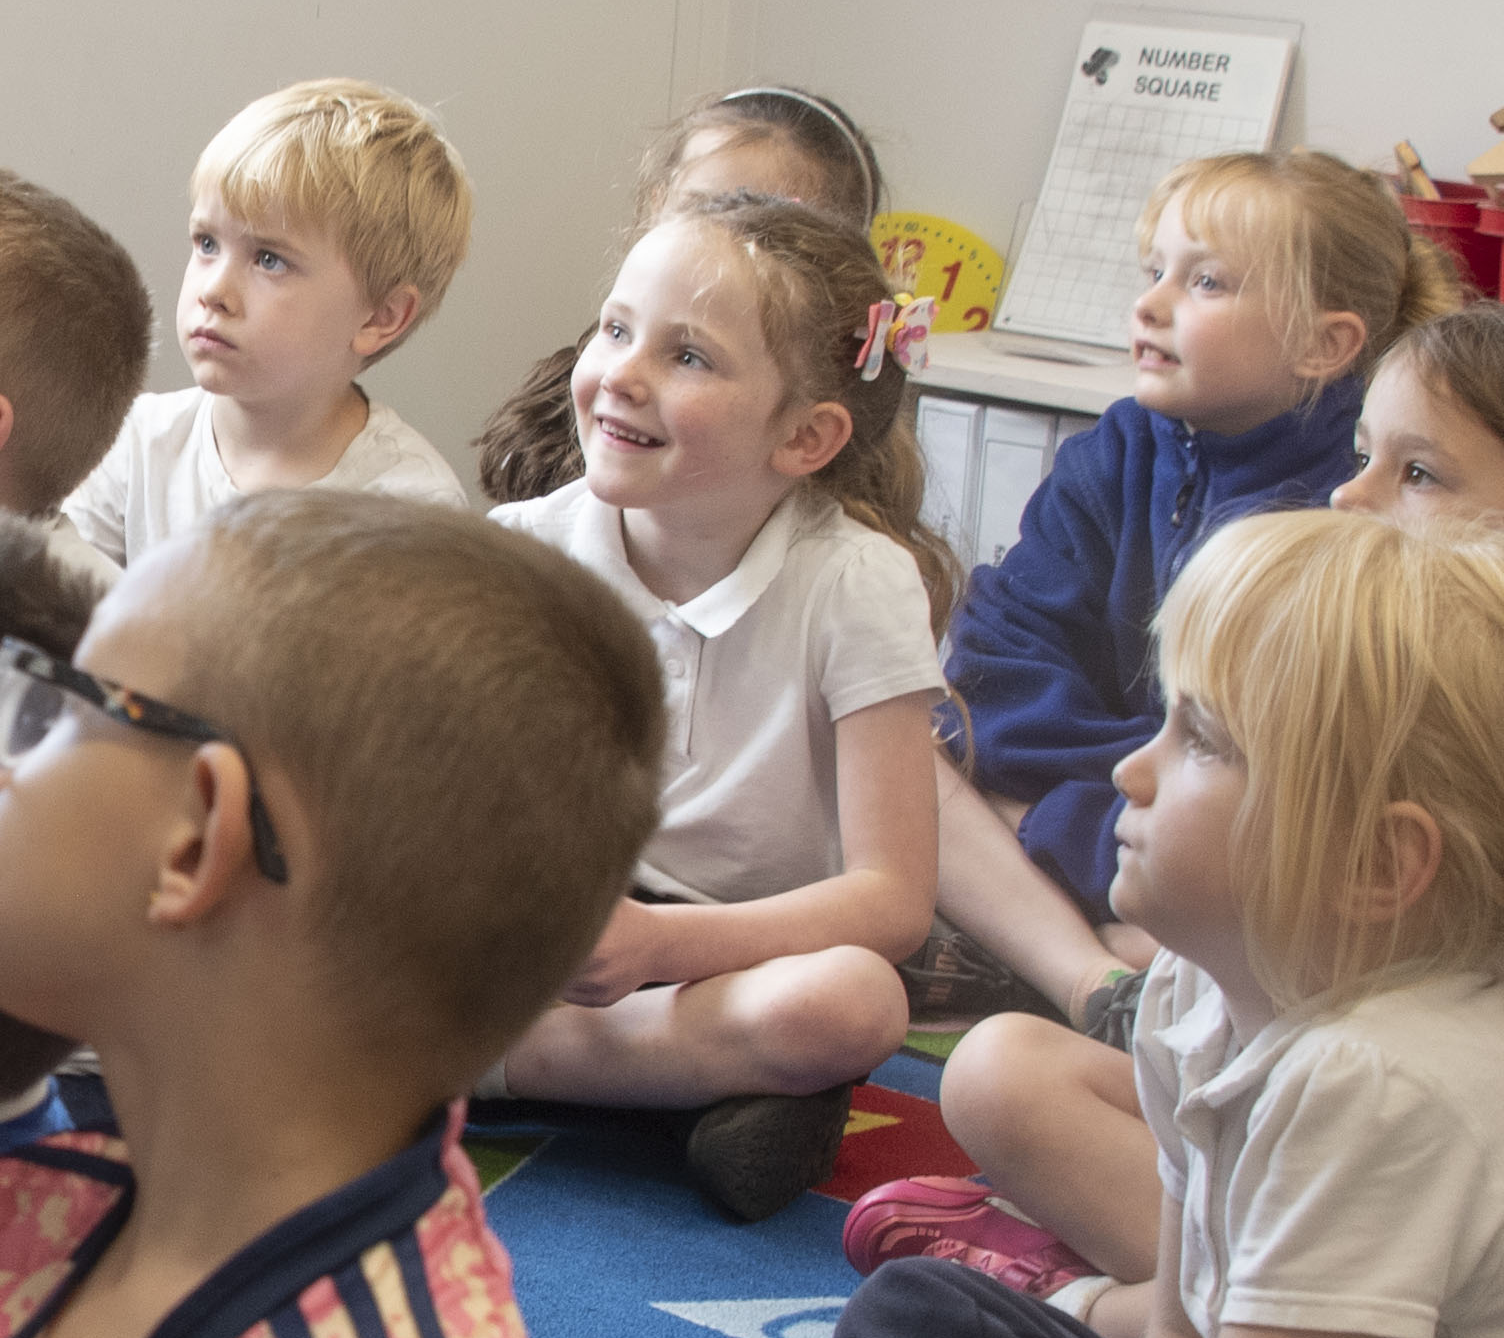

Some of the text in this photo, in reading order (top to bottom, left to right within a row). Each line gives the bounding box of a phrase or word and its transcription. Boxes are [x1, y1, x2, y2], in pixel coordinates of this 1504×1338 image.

[1137, 45, 1232, 73] NUMBER
[1134, 76, 1222, 102] SQUARE
[941, 260, 962, 303] 1
